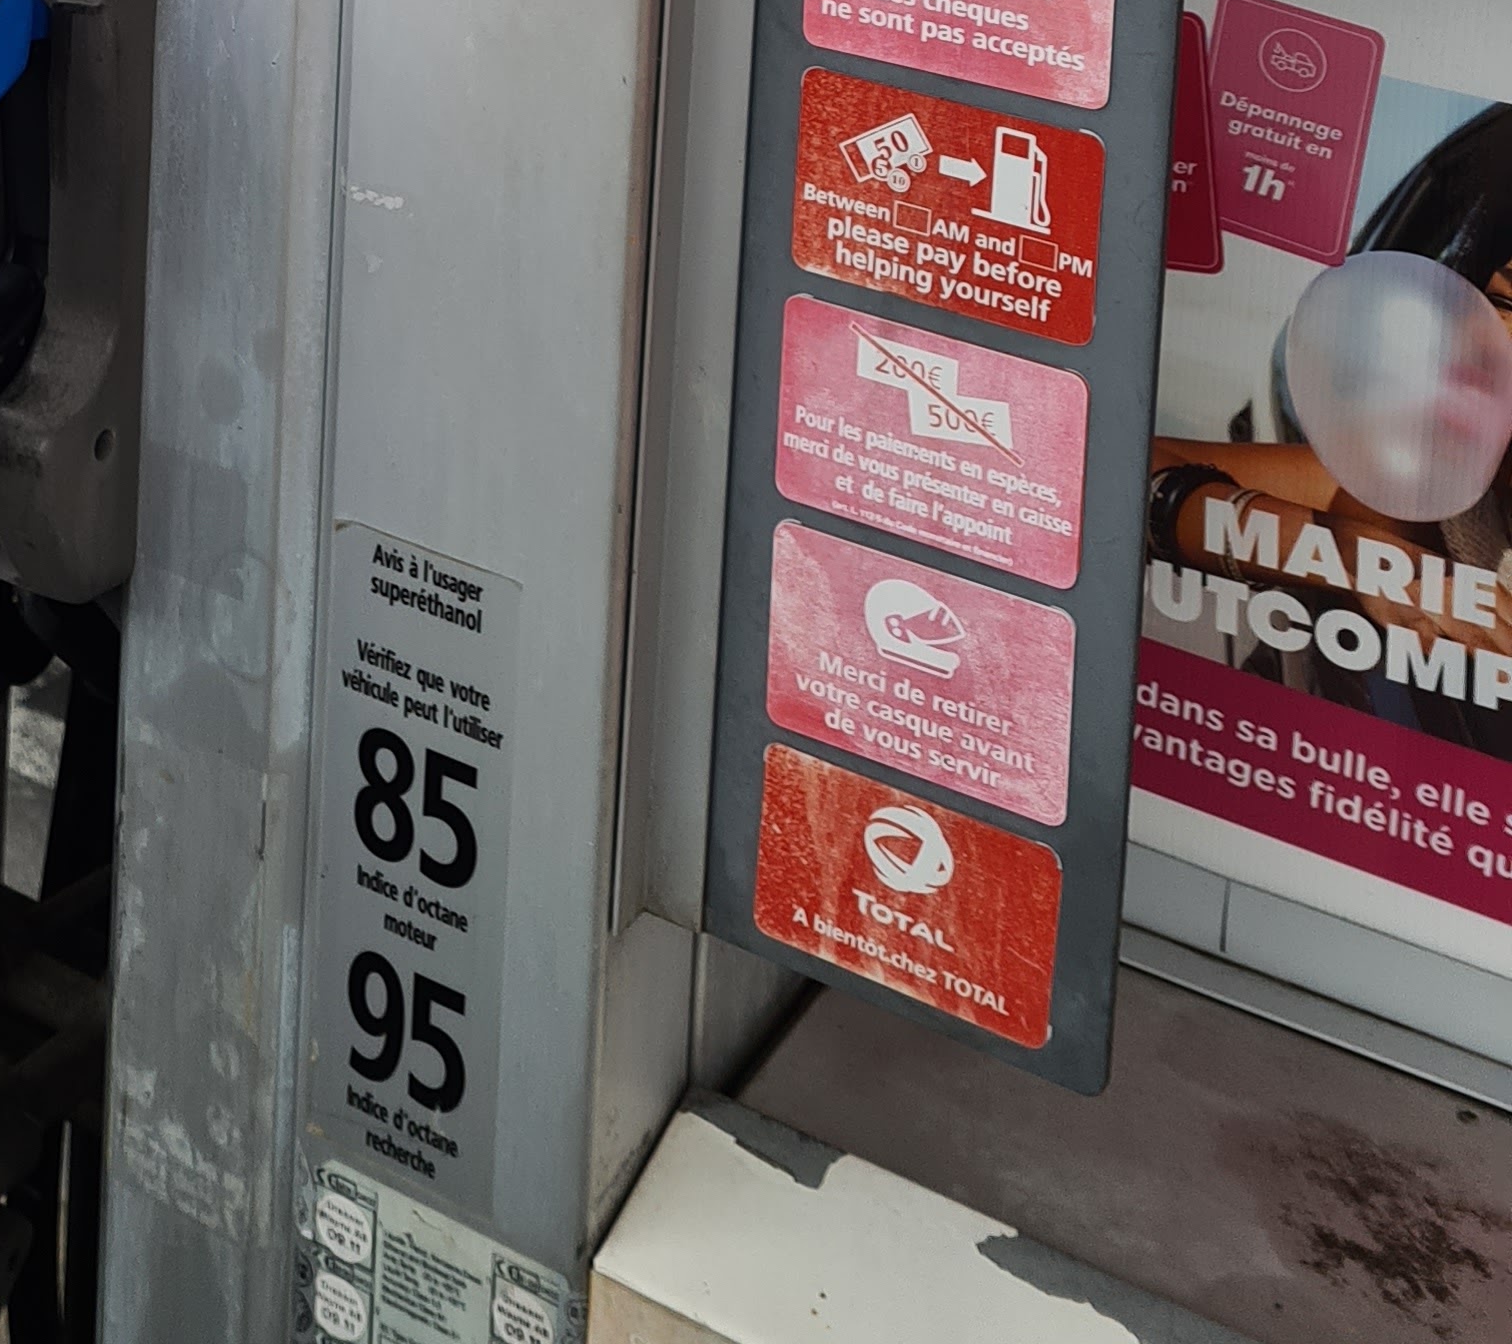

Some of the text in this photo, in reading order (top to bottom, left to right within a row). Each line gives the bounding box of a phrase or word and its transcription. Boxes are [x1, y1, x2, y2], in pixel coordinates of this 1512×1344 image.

[859, 6, 1086, 72] sont pas acceptés
[1219, 90, 1344, 142] Dépannage
[1228, 118, 1302, 150] gratuit
[803, 182, 1093, 278] Between AM and PM
[827, 216, 1063, 299] please pay before
[836, 243, 1051, 322] helping yourself
[783, 431, 829, 459] merci
[903, 467, 987, 510] présenter
[1018, 505, 1073, 537] caisse
[866, 428, 1062, 507] paiements espèces,
[373, 544, 404, 573] Avis
[1202, 496, 1498, 630] MARIE
[371, 577, 482, 633] superéthanol
[342, 669, 438, 724] véhicule peut
[357, 639, 490, 711] Vérifiez votre
[818, 651, 1014, 736] Merci retirer
[796, 672, 1036, 774] votre casque avant
[1136, 681, 1491, 826] dans bulle, elle
[927, 746, 1001, 788] servir
[354, 727, 477, 889] 85
[1308, 780, 1454, 857] fidélité
[357, 864, 398, 901] Indice
[384, 913, 437, 951] moteur
[851, 887, 955, 953] TOTAL
[813, 913, 1010, 1016] bientôt chez TOTAL
[348, 951, 466, 1113] 95
[347, 1084, 388, 1123] Indice
[366, 1130, 435, 1179] recherche
